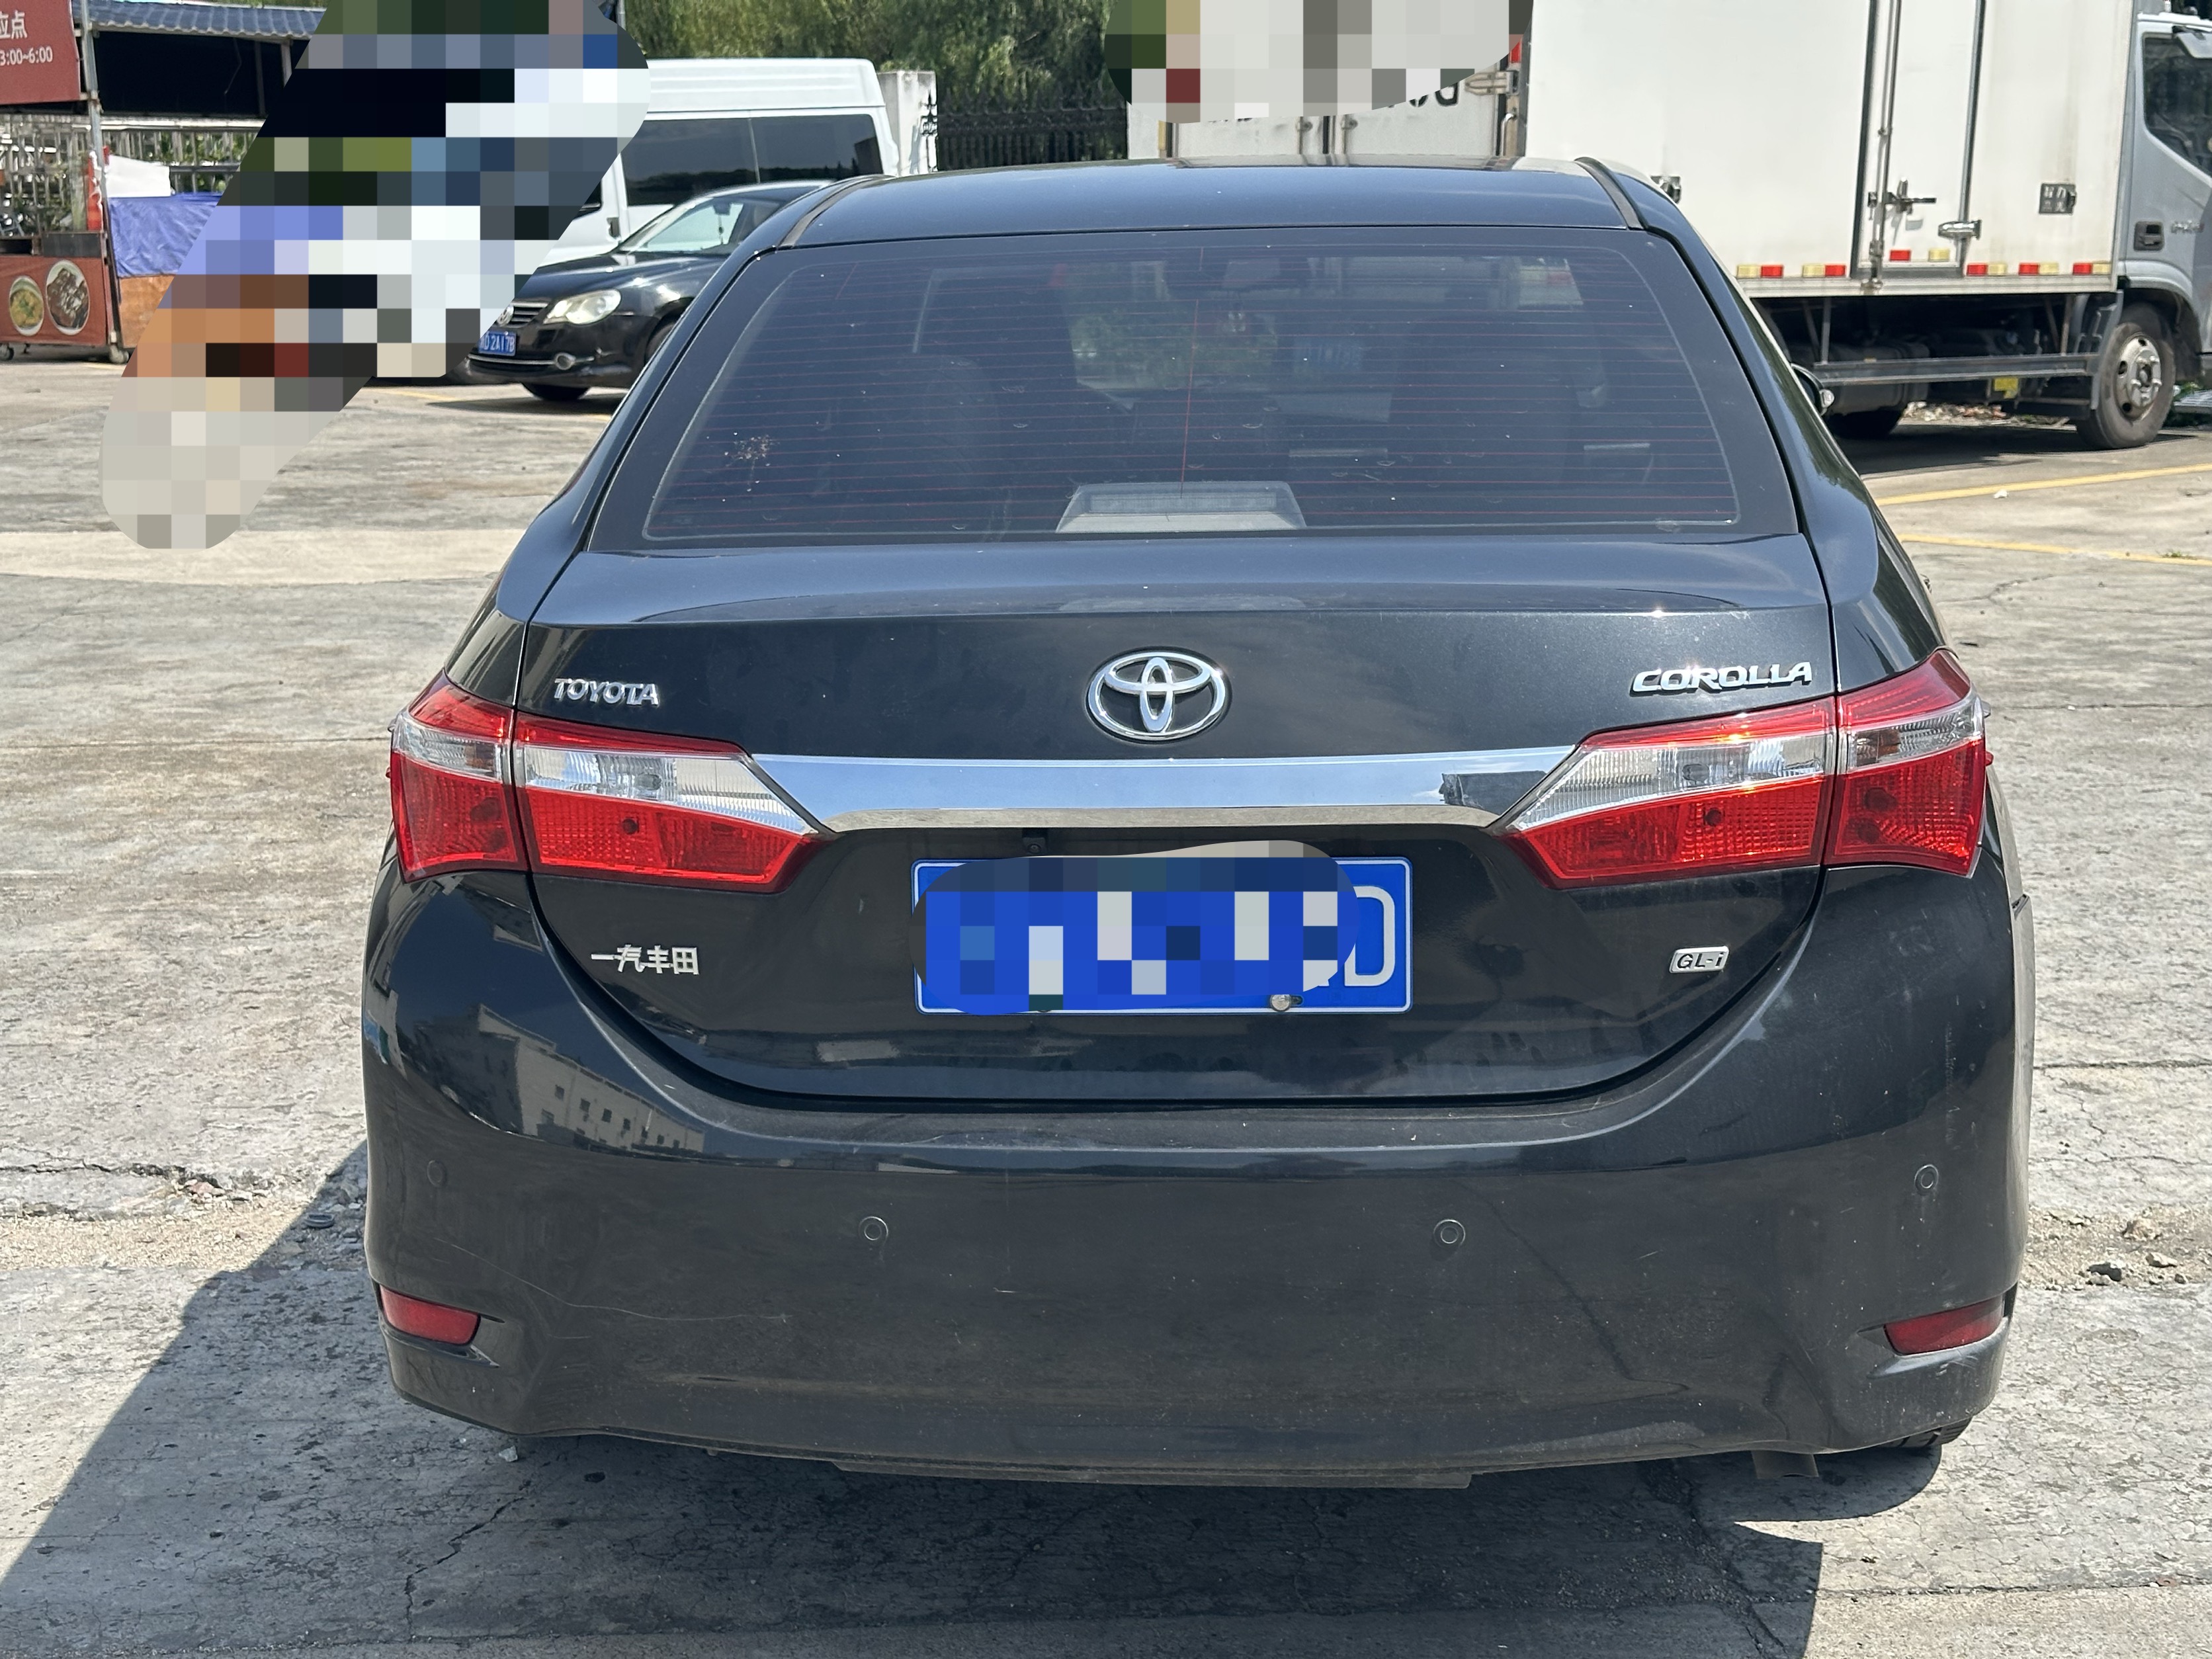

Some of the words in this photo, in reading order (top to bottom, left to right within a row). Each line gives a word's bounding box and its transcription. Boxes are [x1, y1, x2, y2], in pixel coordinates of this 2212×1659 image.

[554, 678, 659, 705] TOYOTA
[1630, 661, 1812, 697] COROLLA
[591, 944, 699, 974] 一汽丰田
